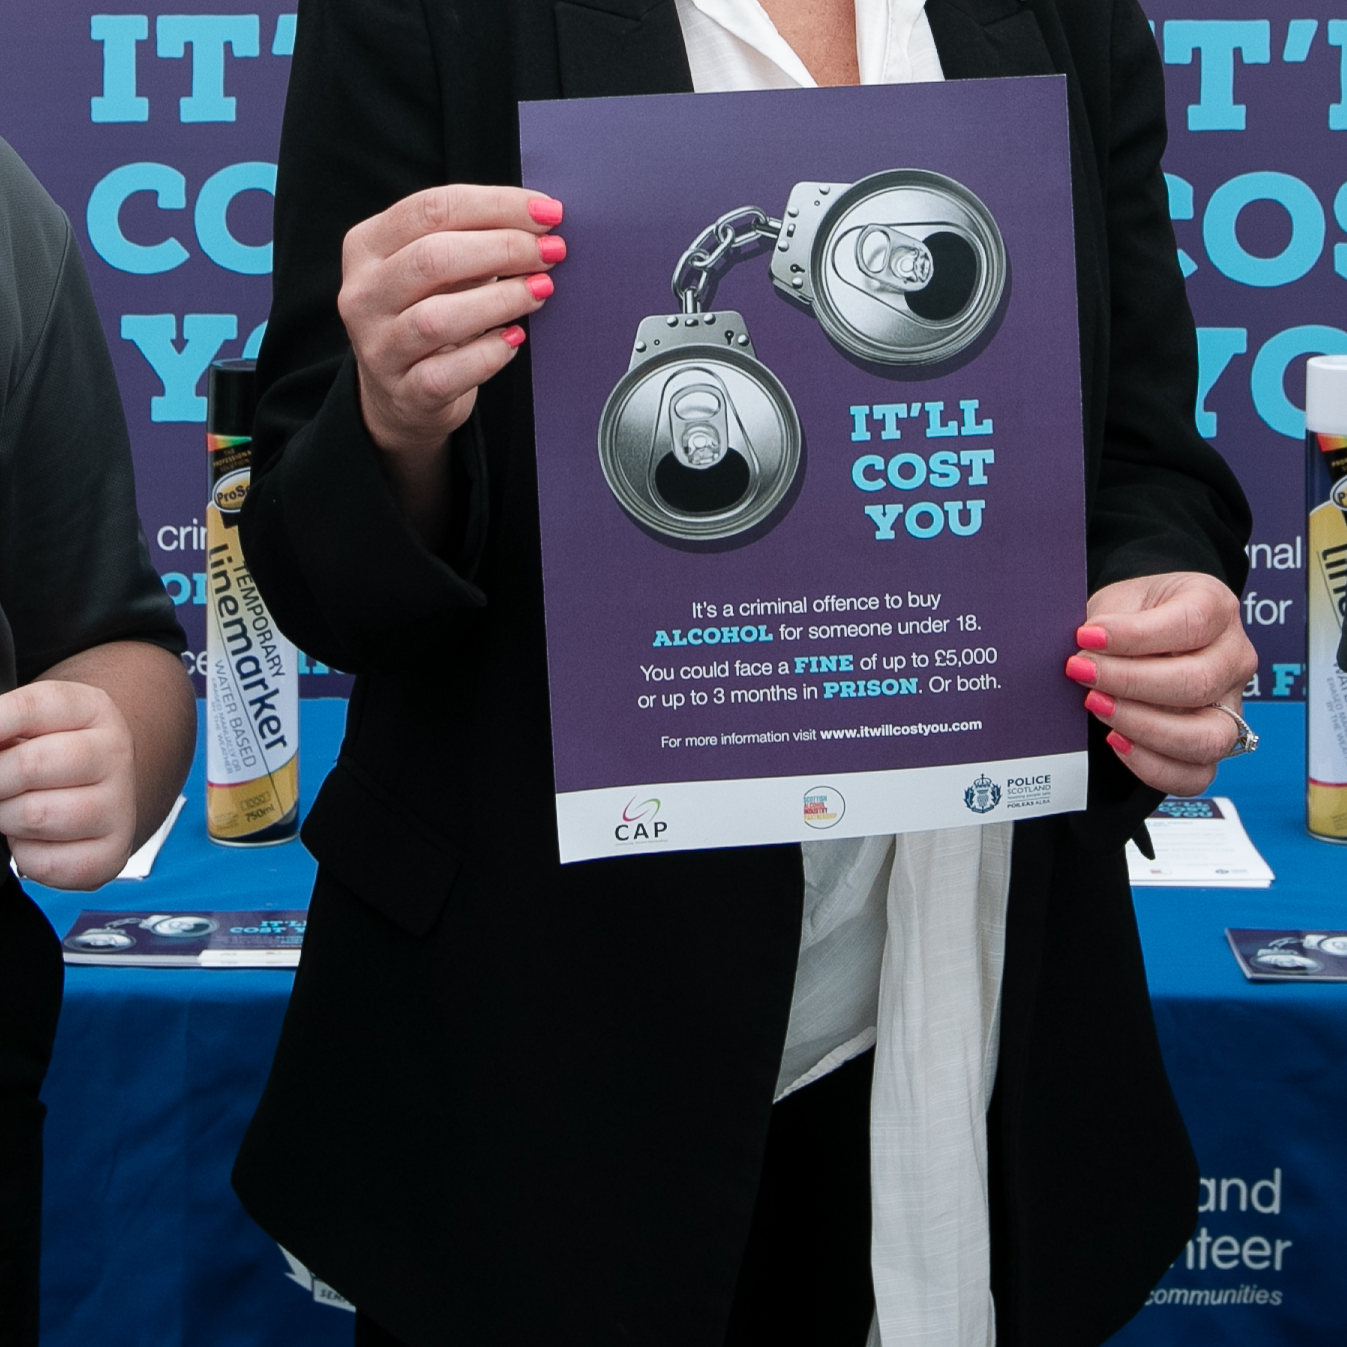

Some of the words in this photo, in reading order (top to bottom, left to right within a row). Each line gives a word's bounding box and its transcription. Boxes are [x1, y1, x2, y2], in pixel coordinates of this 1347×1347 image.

[849, 399, 994, 442] IT'LL
[851, 448, 995, 492] COST
[864, 499, 986, 540] YOU
[232, 561, 286, 679] TEMPORARY
[692, 601, 718, 619] It's
[722, 603, 735, 618] a
[739, 596, 808, 617] criminal
[812, 594, 880, 613] offence
[883, 593, 903, 609] to
[907, 591, 942, 611] buy
[1243, 591, 1294, 626] for
[652, 624, 774, 647] ALCOHOL
[778, 623, 804, 641] for
[808, 622, 893, 640] someone
[897, 616, 951, 635] under
[956, 614, 982, 632] 18.
[639, 664, 675, 682] You
[679, 660, 730, 680] could
[733, 659, 773, 677] face
[777, 661, 790, 675] a
[794, 654, 854, 674] FINE
[859, 653, 878, 671] of
[882, 655, 907, 673] up
[910, 651, 930, 668] to
[934, 647, 998, 668] £5,000
[637, 694, 657, 709] or
[661, 693, 686, 711] up
[689, 689, 708, 706] to
[713, 687, 726, 705] 3
[730, 684, 798, 704] months
[802, 683, 818, 700] in
[823, 677, 923, 699] PRISON.
[928, 675, 953, 693] Or
[956, 673, 1002, 692] both.
[214, 658, 238, 715] WATER
[228, 716, 257, 768] BASED
[661, 735, 683, 748] For
[685, 735, 718, 747] more
[720, 731, 790, 745] information
[792, 729, 817, 742] visit
[819, 720, 983, 740] www.itwillcostyou.com
[1007, 774, 1051, 788] POLICE
[1007, 784, 1052, 795] SCOTLAND
[614, 821, 668, 841] CAP
